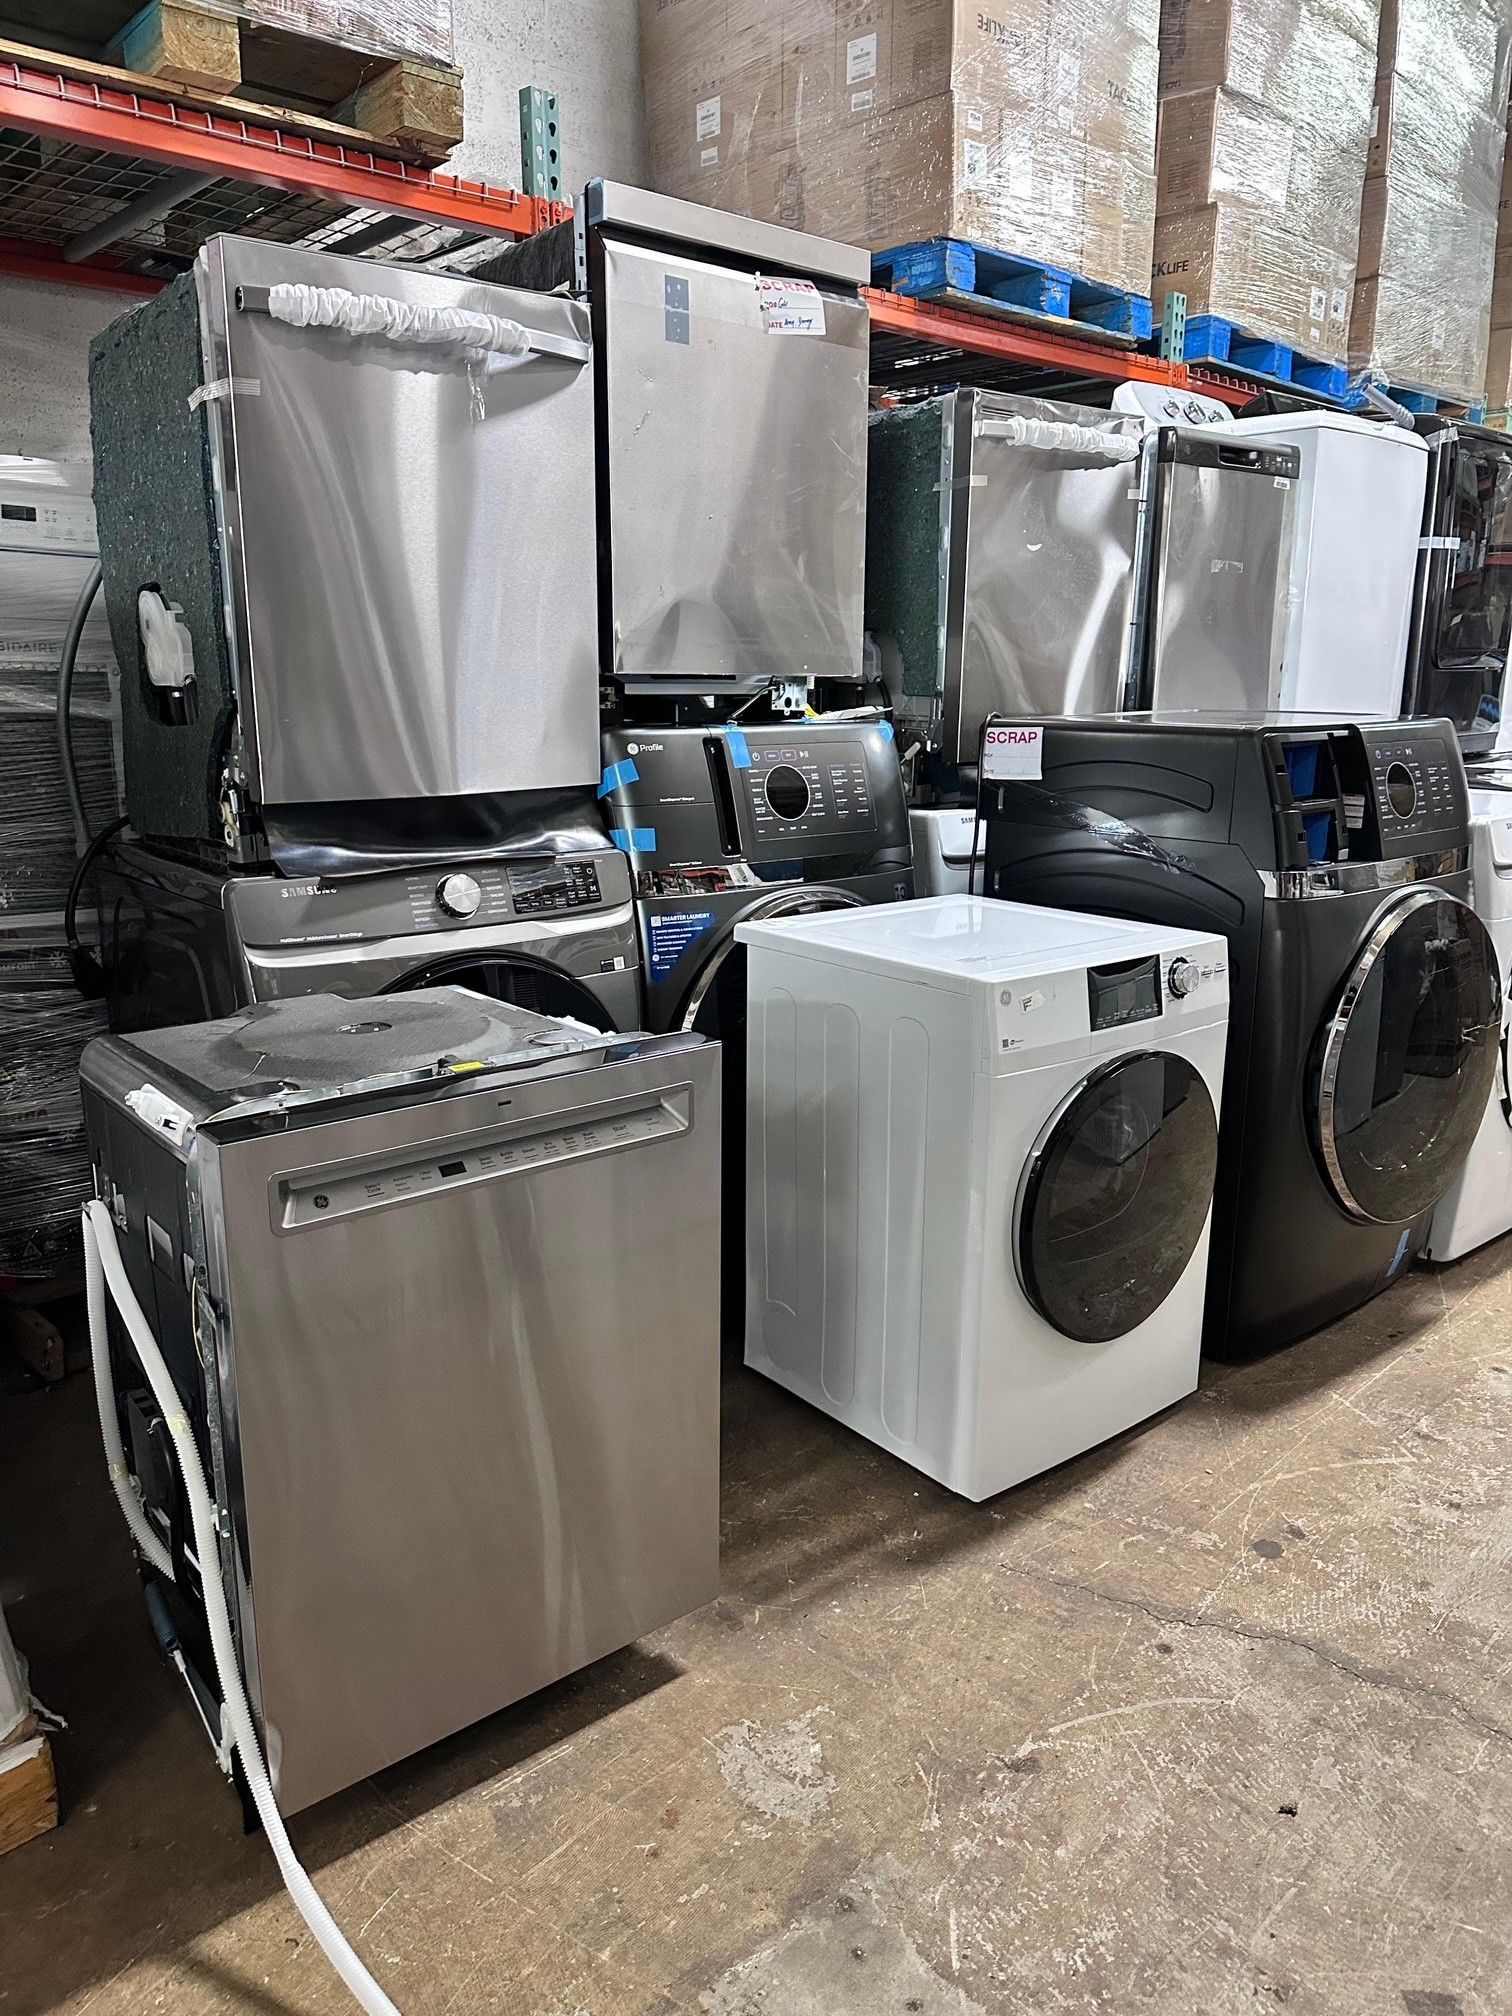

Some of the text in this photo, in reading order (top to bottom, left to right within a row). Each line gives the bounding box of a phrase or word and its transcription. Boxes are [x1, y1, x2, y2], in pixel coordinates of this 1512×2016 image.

[1151, 259, 1190, 279] CKLIFE
[760, 279, 815, 293] SCRAP
[0, 640, 58, 653] GIDAIRE
[986, 731, 1038, 744] SCRAP
[640, 743, 664, 752] Profile
[661, 912, 710, 922] SMARTER LAUNDRY
[612, 1124, 627, 1132] Start
